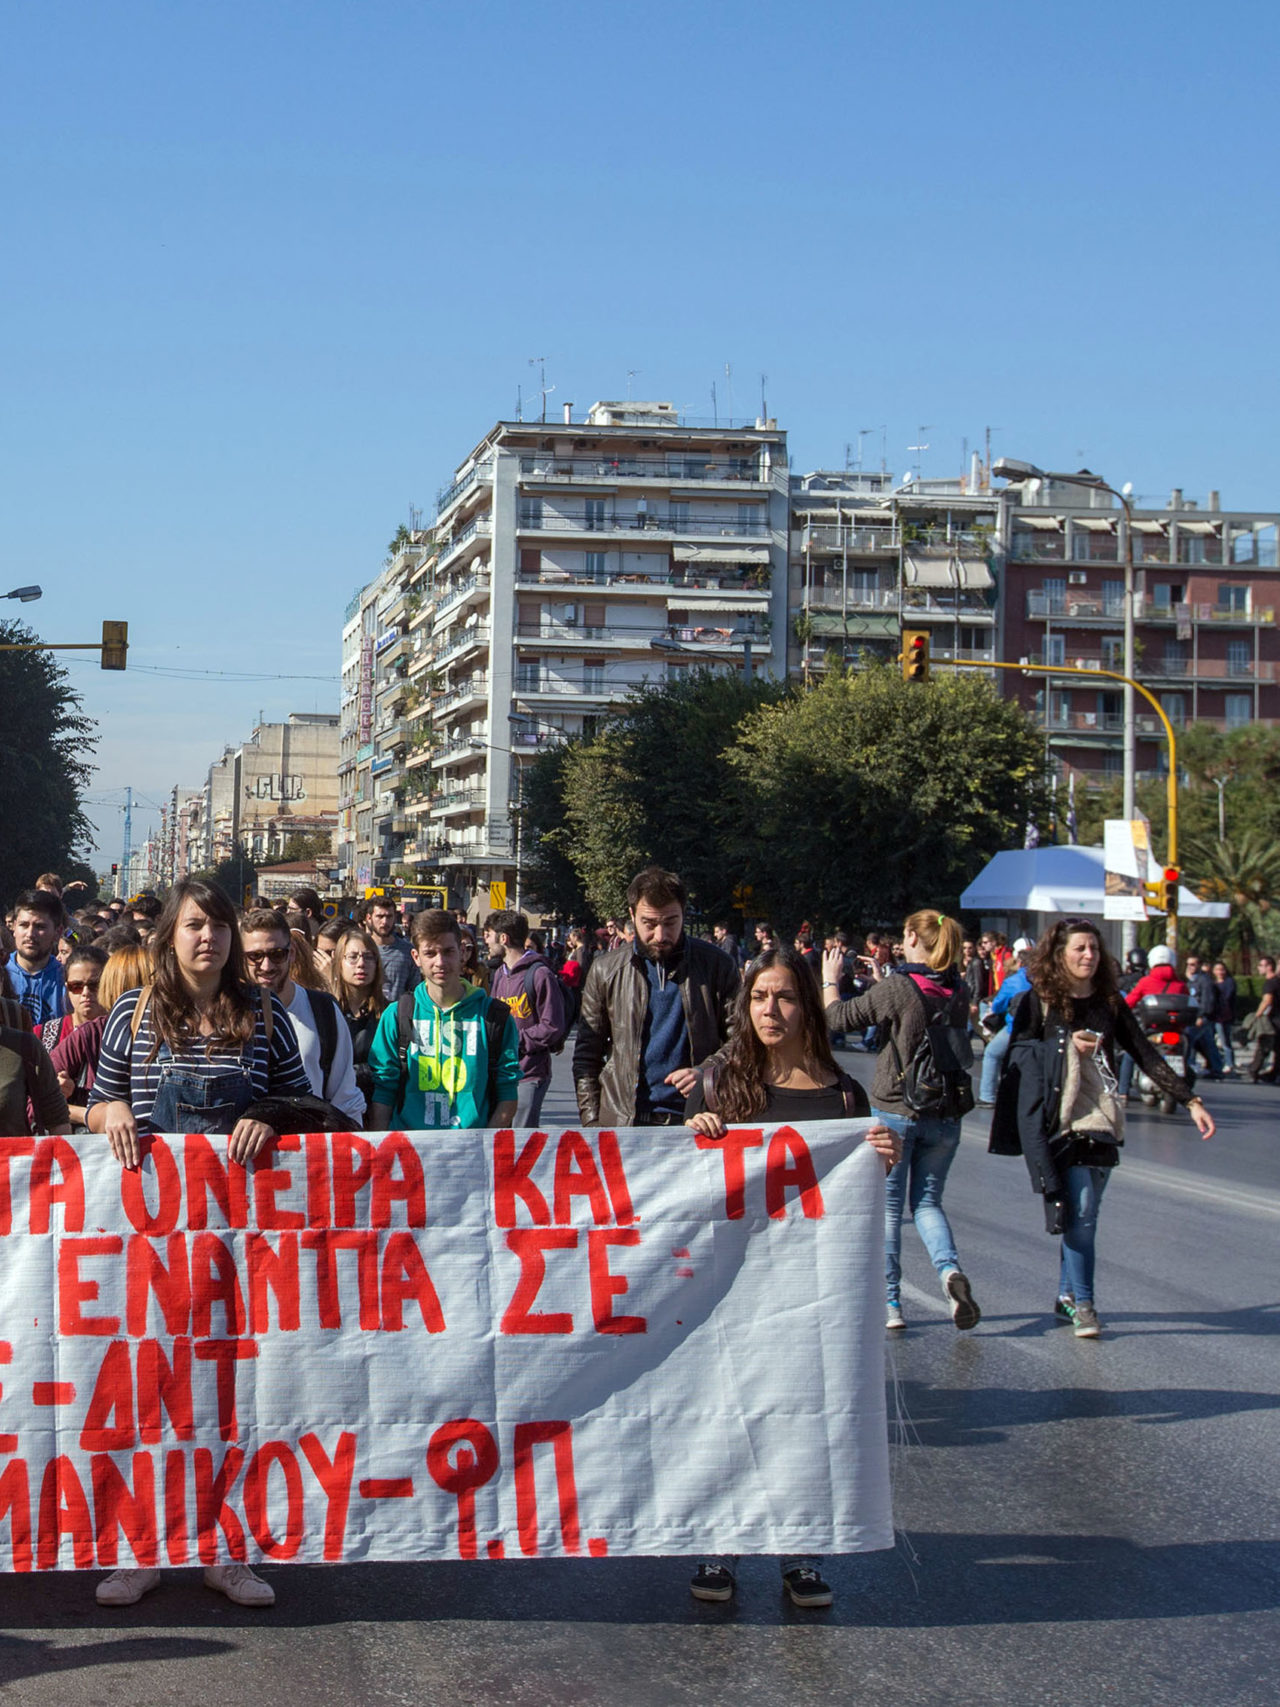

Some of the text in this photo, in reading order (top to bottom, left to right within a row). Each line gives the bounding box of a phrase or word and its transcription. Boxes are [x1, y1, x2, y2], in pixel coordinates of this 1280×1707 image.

[418, 1056, 467, 1092] DO
[121, 1131, 426, 1236] ΟΝΕΙΡΑ
[494, 1130, 640, 1227] ΚΑΙ
[695, 1126, 824, 1219] ΤΑ
[501, 1228, 646, 1335] ΣΕ
